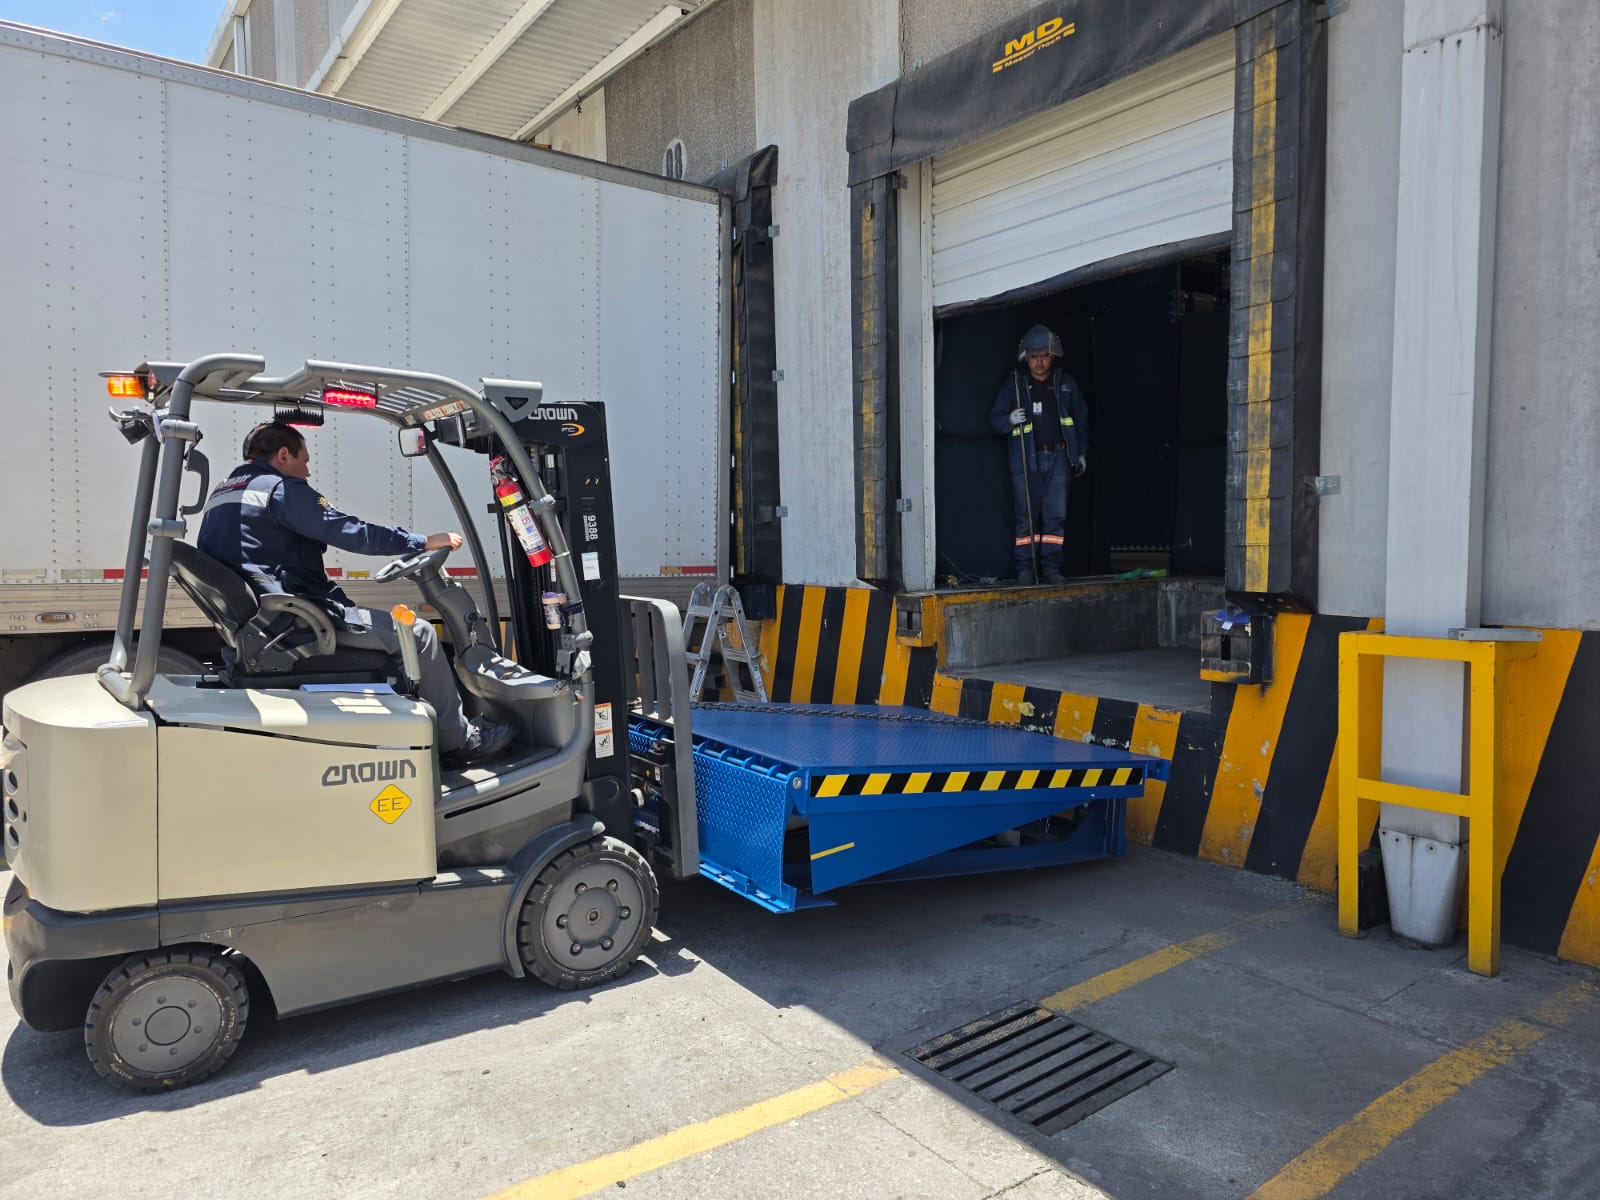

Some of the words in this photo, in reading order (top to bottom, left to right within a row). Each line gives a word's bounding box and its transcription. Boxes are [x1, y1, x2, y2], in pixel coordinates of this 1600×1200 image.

[1005, 17, 1063, 56] MD
[587, 514, 599, 540] 9388
[321, 759, 417, 787] CROWN
[377, 796, 404, 812] EE
